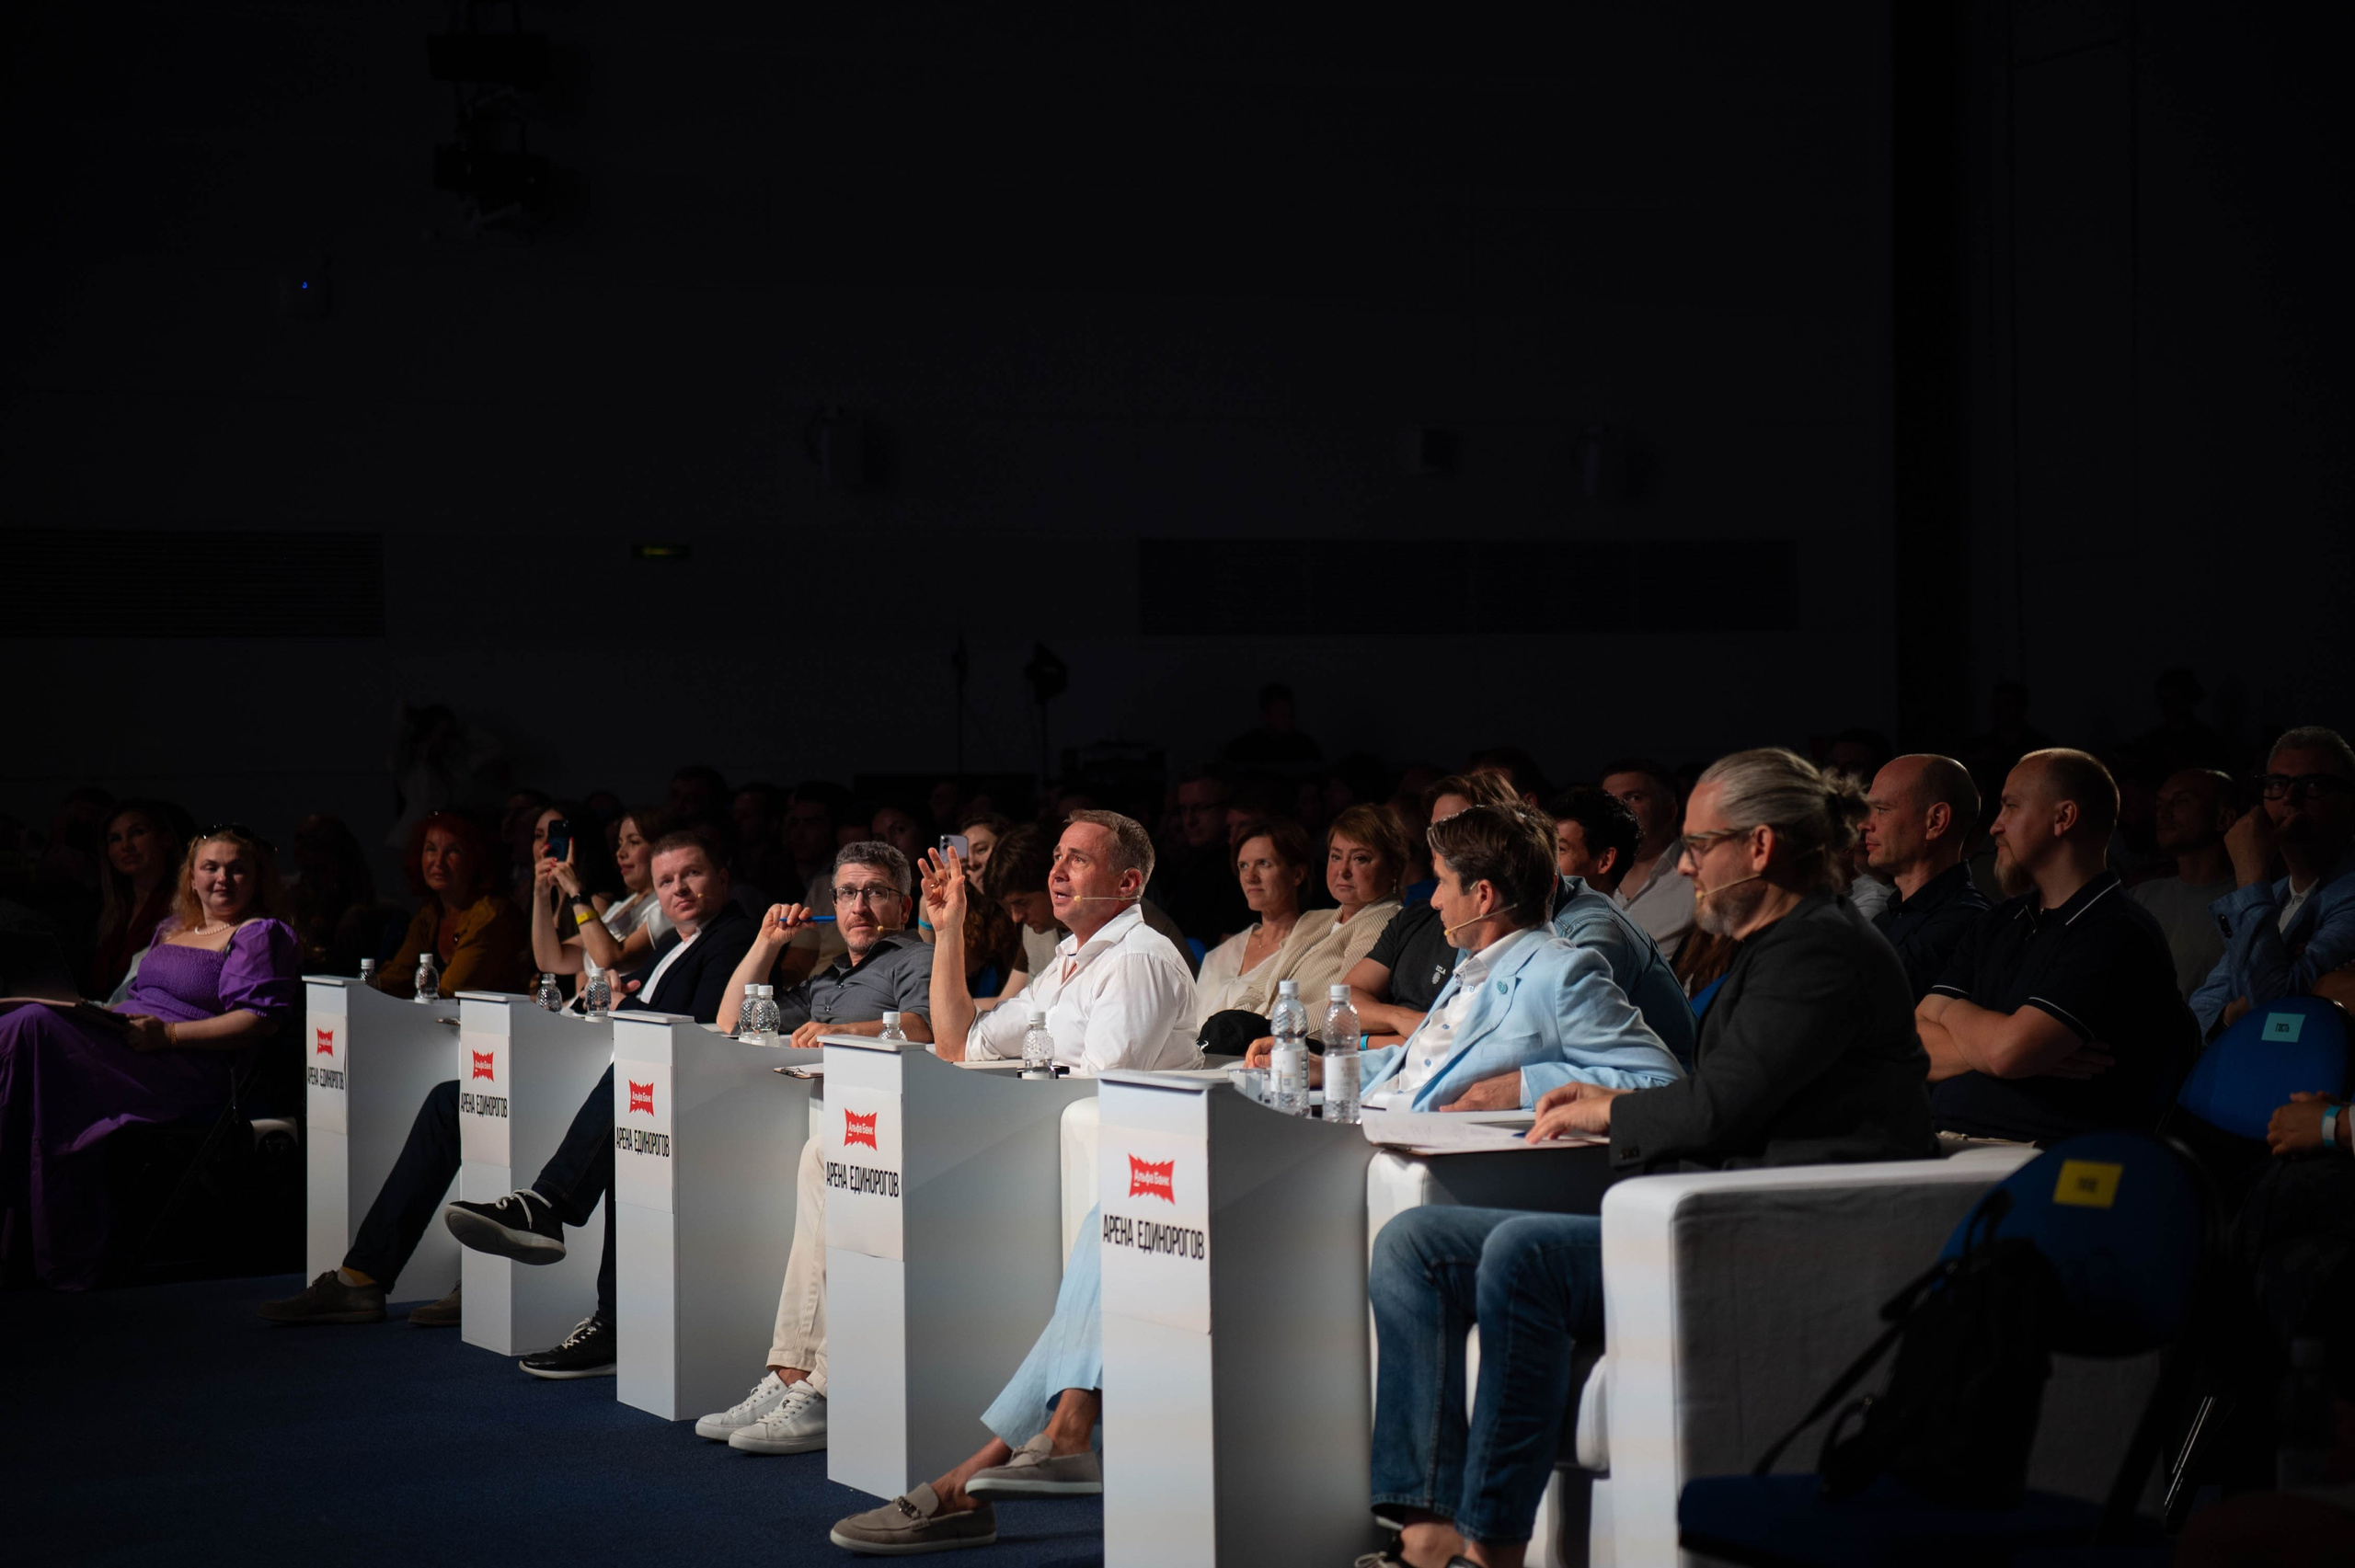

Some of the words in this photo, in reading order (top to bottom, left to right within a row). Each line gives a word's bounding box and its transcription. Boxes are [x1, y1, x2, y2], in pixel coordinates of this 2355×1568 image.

[460, 1092, 476, 1115] АРЕНА
[477, 1093, 509, 1118] ЕДИНОРОГОВ
[616, 1127, 633, 1150] АРЕНА
[634, 1129, 670, 1158] ЕДИНОРОГОВ
[826, 1161, 848, 1189] АРЕНА
[850, 1165, 900, 1198] ЕДИНОРОГОВ
[1133, 1169, 1155, 1186] Альфа
[1155, 1172, 1170, 1186] Банк
[1103, 1214, 1133, 1248] АРЕНА
[1138, 1220, 1205, 1261] ЕДИНОРОГОВ
